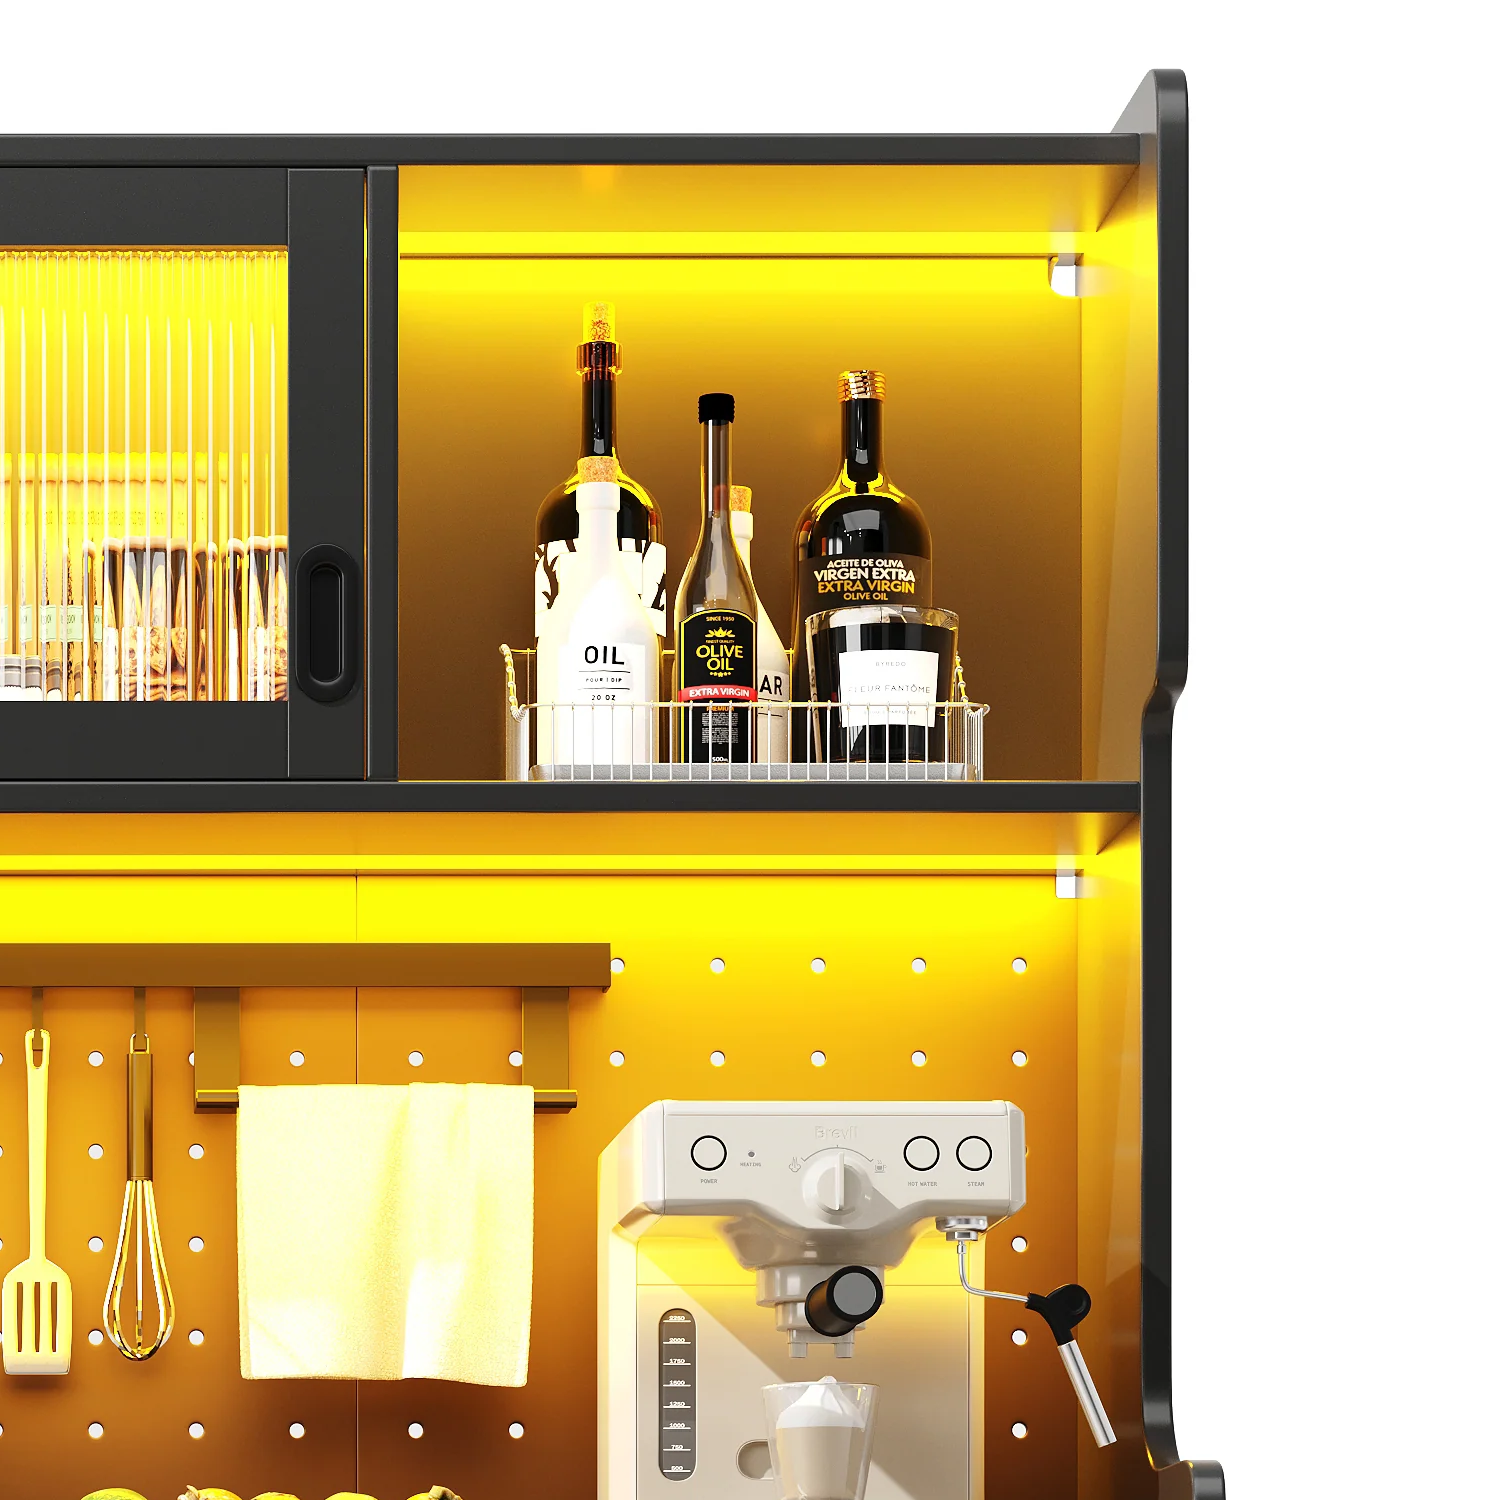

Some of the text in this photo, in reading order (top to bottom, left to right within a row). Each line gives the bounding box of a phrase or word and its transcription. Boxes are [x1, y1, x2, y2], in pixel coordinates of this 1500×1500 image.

[827, 559, 904, 569] ACEITE DE OLIVA
[814, 568, 916, 583] VIRGEN EXTRA
[818, 580, 915, 594] EXTRA VIRGIN
[843, 592, 888, 601] OLIVE OIL
[584, 645, 625, 665] OIL
[695, 645, 744, 658] OLIVE
[706, 657, 735, 671] OIL
[689, 687, 750, 698] EXTRA VIRGIN
[884, 683, 931, 694] FANTÔME
